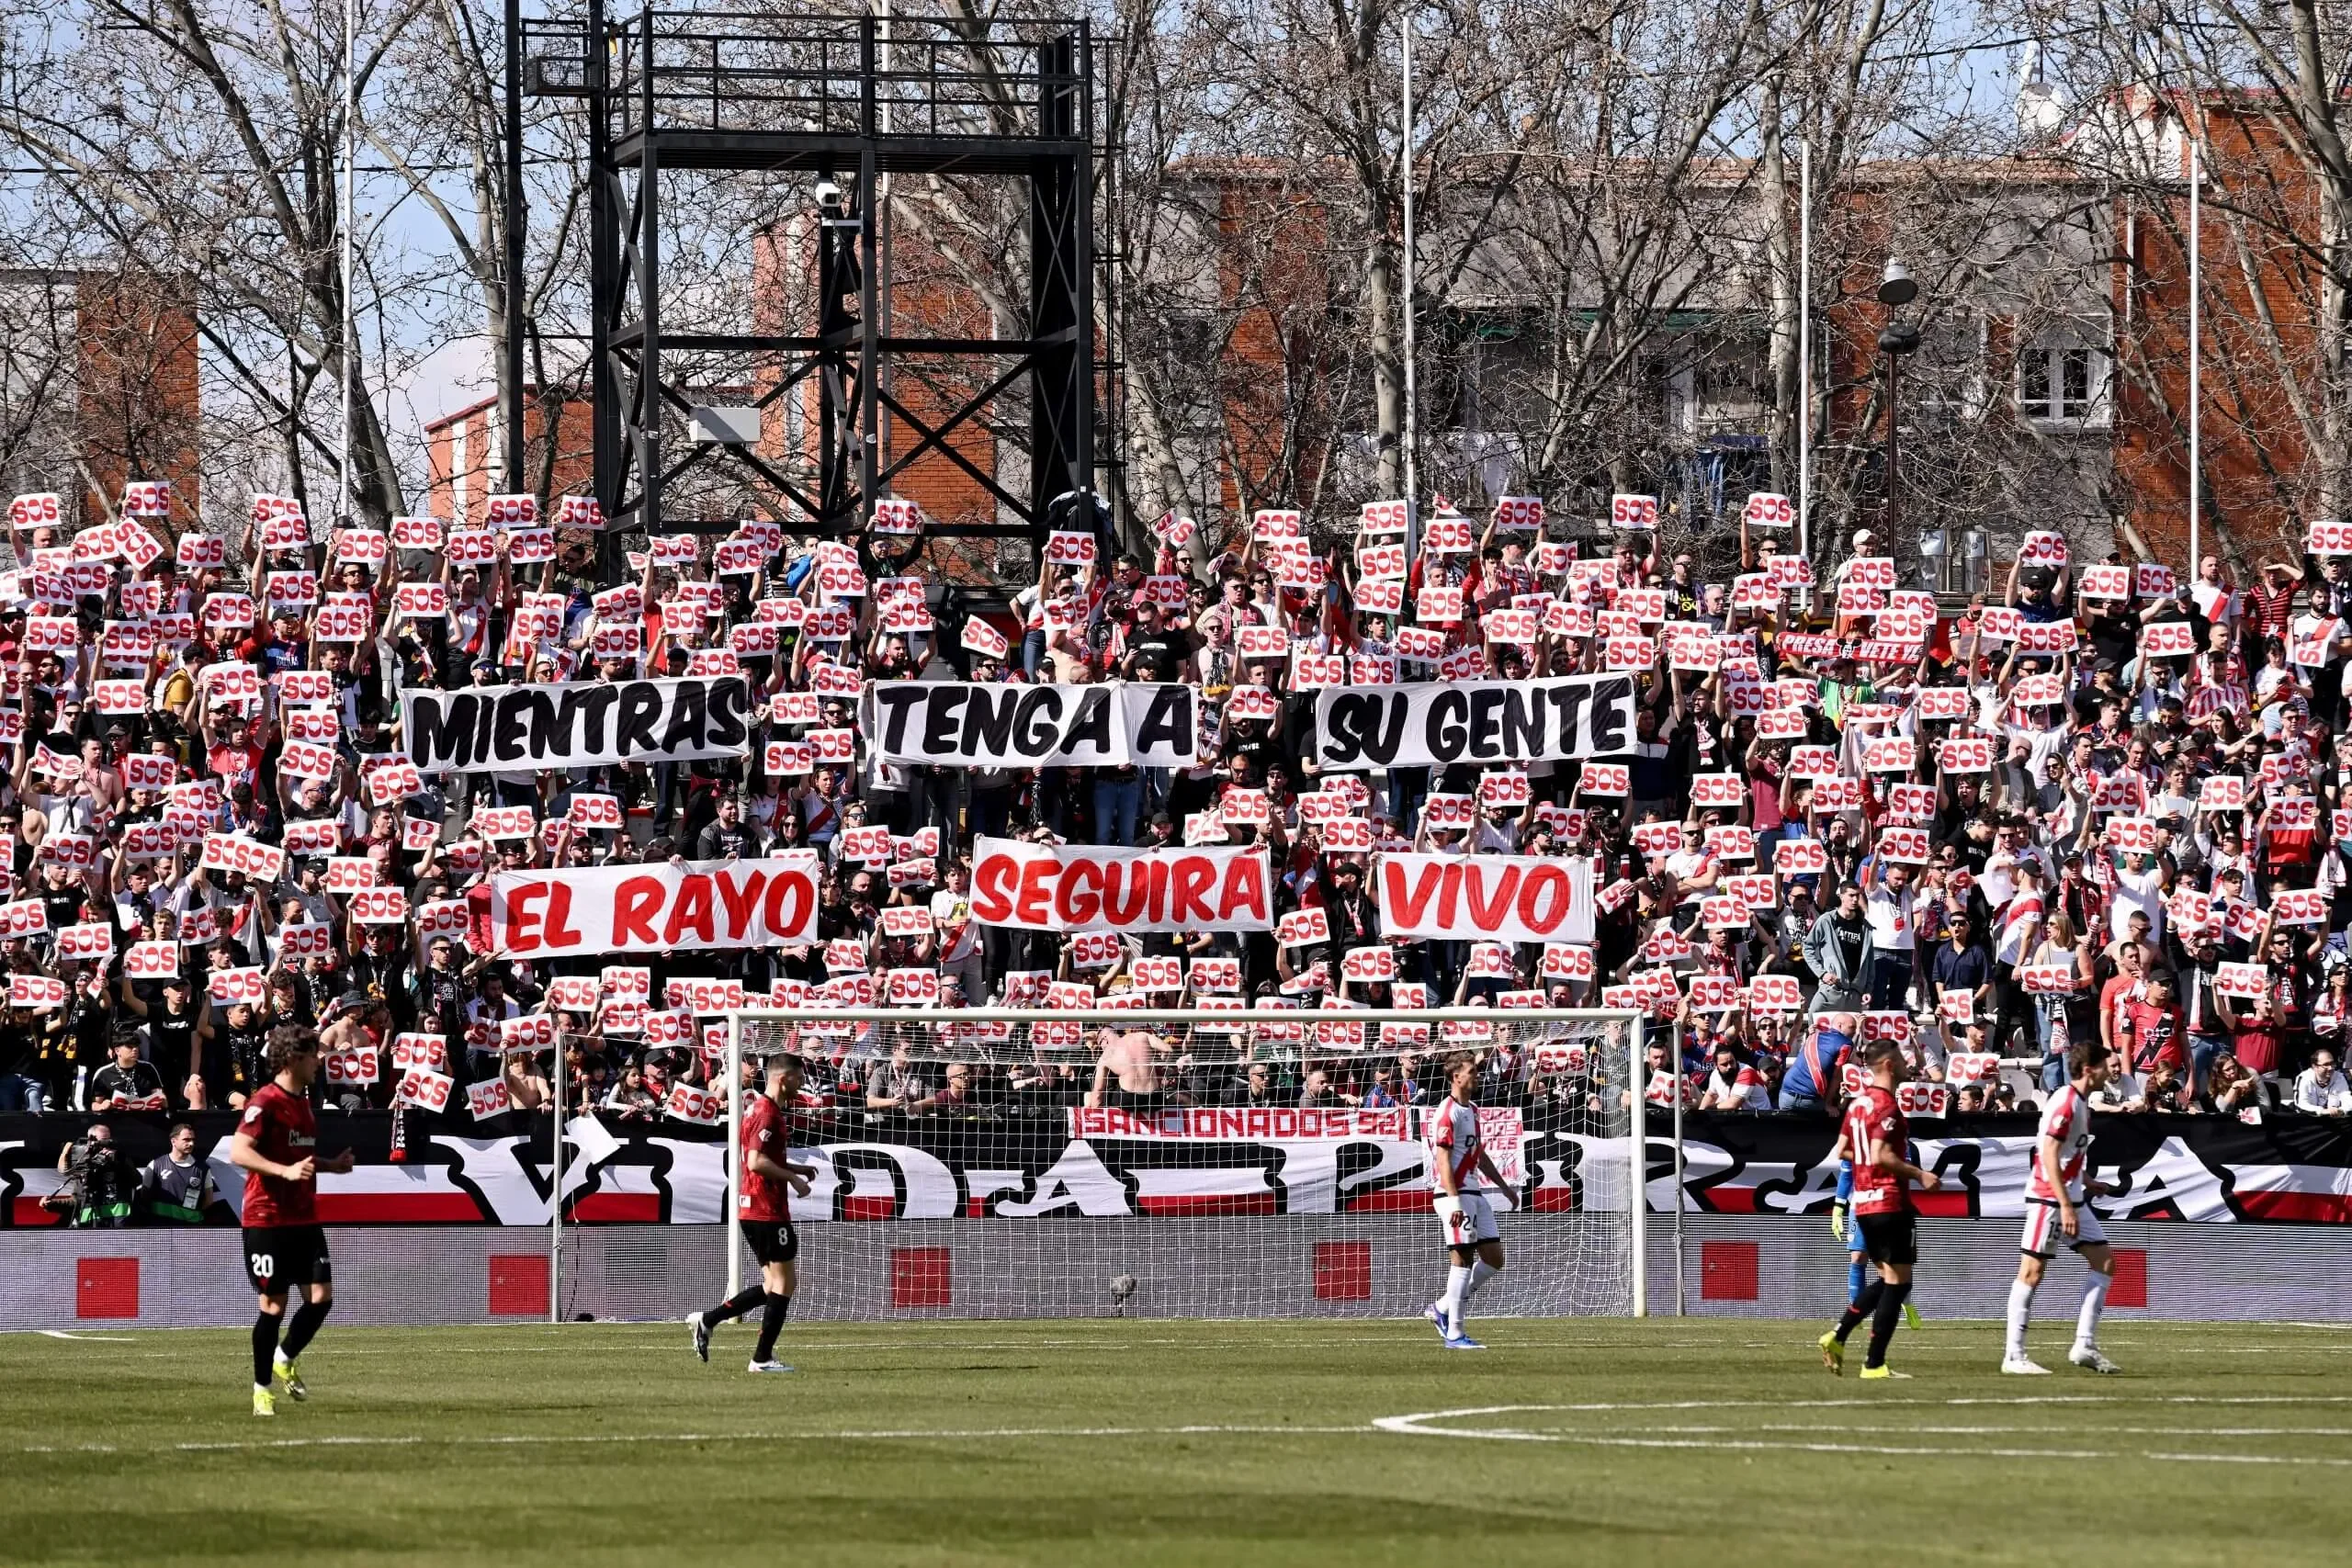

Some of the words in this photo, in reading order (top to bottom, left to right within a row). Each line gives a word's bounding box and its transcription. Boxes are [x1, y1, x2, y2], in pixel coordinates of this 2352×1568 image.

[12, 499, 58, 522] SOS
[130, 490, 170, 512] SOS
[492, 500, 533, 522] SOS
[1614, 500, 1656, 523] SOS
[1749, 498, 1792, 522] SOS
[560, 502, 600, 524] SOS
[876, 505, 917, 527] SOS
[1365, 506, 1406, 528] SOS
[1500, 502, 1542, 525] SOS
[264, 518, 306, 545] SOS
[397, 524, 438, 543] SOS
[1256, 515, 1299, 536] SOS
[1428, 525, 1471, 547] SOS
[76, 533, 117, 557] SOS
[116, 523, 155, 563] SOS
[180, 539, 223, 562] SOS
[340, 534, 384, 558] SOS
[450, 537, 495, 560] SOS
[512, 535, 553, 554] SOS
[1052, 536, 1093, 559] SOS
[720, 546, 761, 568] SOS
[1363, 551, 1404, 575] SOS
[822, 569, 865, 591] SOS
[1283, 562, 1322, 583] SOS
[1852, 563, 1894, 583] SOS
[2086, 572, 2126, 593] SOS
[2140, 572, 2175, 592] SOS
[35, 575, 74, 600] SOS
[270, 576, 315, 600] SOS
[1148, 581, 1186, 603] SOS
[1359, 585, 1401, 609] SOS
[1840, 587, 1883, 610] SOS
[209, 599, 253, 621] SOS
[399, 590, 446, 610] SOS
[597, 590, 639, 615] SOS
[1421, 593, 1461, 615] SOS
[517, 613, 559, 634] SOS
[760, 602, 803, 622] SOS
[889, 604, 930, 625] SOS
[1548, 608, 1592, 631] SOS
[28, 621, 75, 642] SOS
[150, 617, 190, 637] SOS
[320, 613, 364, 636] SOS
[806, 616, 851, 637] SOS
[1493, 616, 1534, 637] SOS
[1880, 615, 1924, 636] SOS
[107, 627, 152, 649] SOS
[594, 628, 639, 651] SOS
[736, 628, 775, 652] SOS
[967, 624, 1006, 652] SOS
[1241, 631, 1285, 651] SOS
[1397, 632, 1441, 658] SOS
[1782, 635, 1835, 655] PRESA
[1859, 642, 1897, 660] VETE
[2019, 628, 2061, 650] SOS
[2148, 628, 2190, 649] SOS
[1609, 643, 1653, 666] SOS
[1675, 643, 1717, 666] SOS
[1298, 660, 1342, 682] SOS
[1352, 660, 1395, 683] SOS
[1441, 653, 1487, 681] SOS
[212, 671, 258, 694] SOS
[283, 677, 332, 699] SOS
[817, 668, 862, 692] SOS
[97, 686, 144, 708] SOS
[774, 696, 818, 718] SOS
[775, 697, 817, 717] SOS
[1235, 692, 1274, 713] SOS
[1734, 689, 1779, 710] SOS
[1922, 694, 1965, 714] SOS
[292, 715, 336, 734] SOS
[413, 677, 747, 768] MIENTRAS
[877, 685, 1110, 757] TENGA
[1136, 685, 1193, 756] A
[1323, 692, 1408, 765] SU
[1426, 677, 1633, 762] GENTE
[1761, 713, 1803, 734] SOS
[286, 745, 332, 775] SOS
[767, 749, 811, 770] SOS
[1793, 751, 1836, 773] SOS
[1869, 743, 1912, 766] SOS
[1943, 745, 1989, 767] SOS
[130, 760, 173, 783] SOS
[1583, 767, 1625, 790] SOS
[373, 769, 419, 798] SOS
[1483, 777, 1526, 800] SOS
[1699, 778, 1740, 800] SOS
[2097, 783, 2138, 807] SOS
[174, 786, 218, 809] SOS
[574, 799, 617, 819] SOS
[1222, 794, 1265, 818] SOS
[1303, 797, 1346, 818] SOS
[1894, 788, 1937, 815] SOS
[1430, 798, 1472, 822] SOS
[486, 815, 531, 833] SOS
[1326, 820, 1369, 846] SOS
[2109, 823, 2154, 848] SOS
[129, 825, 175, 852] SOS
[845, 833, 890, 854] SOS
[1635, 828, 1679, 852] SOS
[1883, 832, 1927, 858] SOS
[45, 840, 89, 865] SOS
[235, 846, 280, 872] SOS
[1778, 846, 1823, 868] SOS
[331, 863, 371, 887] SOS
[971, 853, 1264, 925] SEGUIRA
[1385, 861, 1571, 935] VIVO
[356, 892, 401, 917] SOS
[507, 881, 582, 953] EL
[611, 869, 815, 946] RAYO
[1704, 901, 1746, 920] SOS
[2278, 897, 2324, 919] SOS
[884, 909, 930, 930] SOS
[62, 929, 109, 953] SOS
[283, 930, 327, 953] SOS
[1077, 936, 1119, 961] SOS
[129, 948, 175, 972] SOS
[829, 945, 863, 967] SOS
[1349, 952, 1392, 976] SOS
[1546, 948, 1589, 975] SOS
[1136, 963, 1179, 986] SOS
[1195, 964, 1237, 985] SOS
[2025, 970, 2068, 990] SOS
[15, 979, 62, 999] SOS
[211, 974, 261, 999] SOS
[554, 981, 594, 1005] SOS
[695, 985, 741, 1010] SOS
[892, 976, 936, 997] SOS
[1692, 980, 1735, 1005] SOS
[1753, 980, 1798, 1003] SOS
[506, 1021, 550, 1048] SOS
[649, 1012, 691, 1043] SOS
[1865, 1016, 1908, 1040] SOS
[399, 1040, 441, 1064] SOS
[329, 1054, 376, 1077] SOS
[404, 1073, 447, 1105] SOS
[674, 1089, 716, 1120] SOS
[1900, 1089, 1944, 1113] SOS
[1082, 1108, 1350, 1138] SANCIONADOS
[1850, 1117, 1871, 1167] 11
[778, 1227, 789, 1247] 8
[251, 1253, 274, 1279] 20
